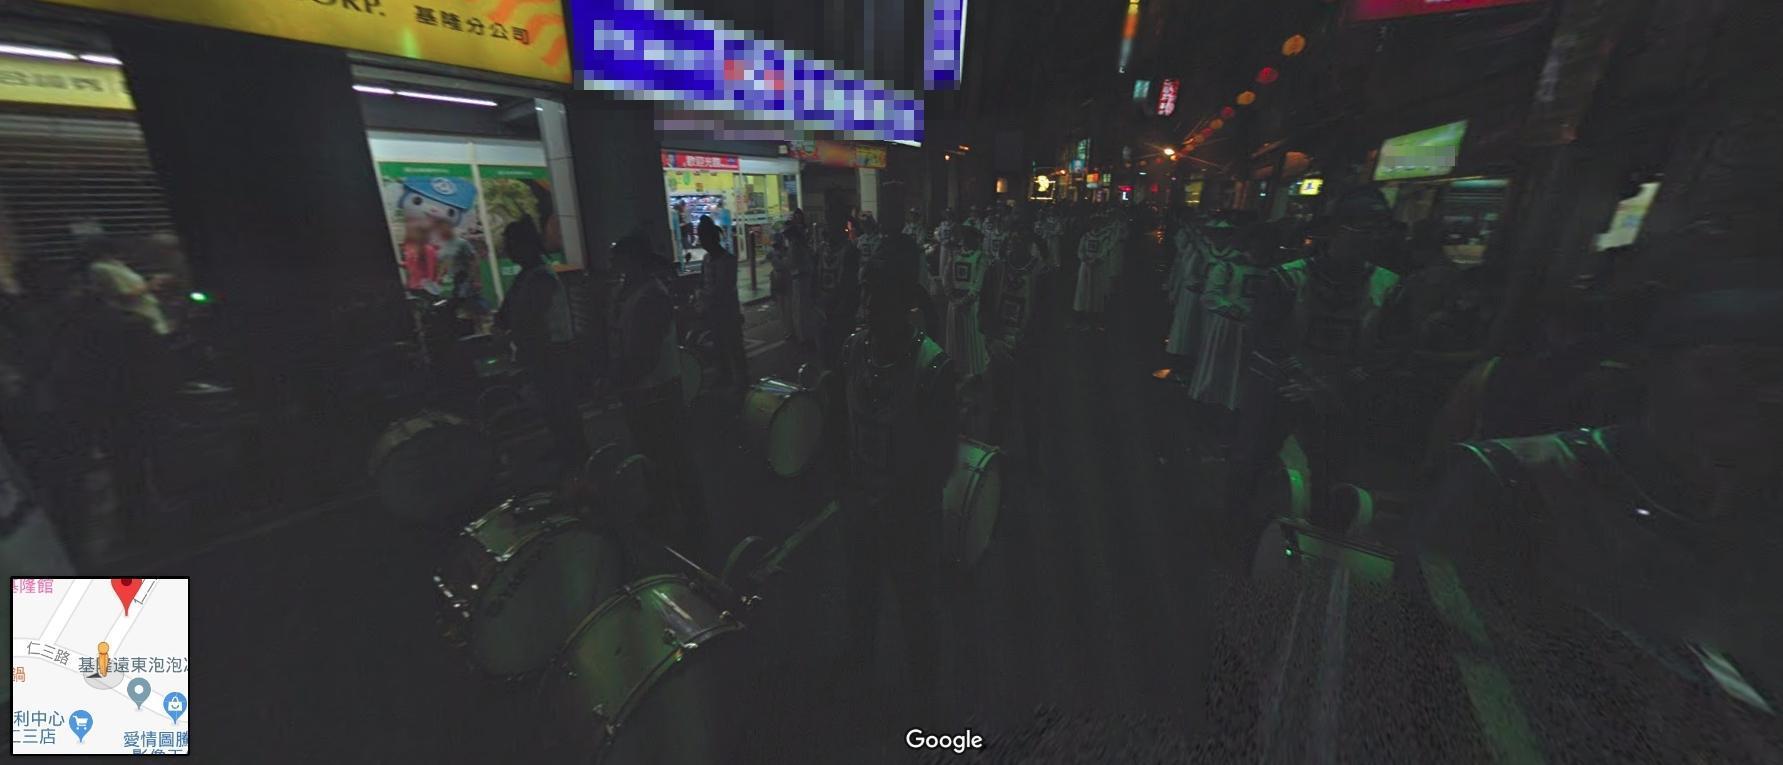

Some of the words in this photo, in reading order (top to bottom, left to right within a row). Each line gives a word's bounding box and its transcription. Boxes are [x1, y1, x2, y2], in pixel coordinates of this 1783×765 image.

[413, 5, 531, 46] 基隆分公司
